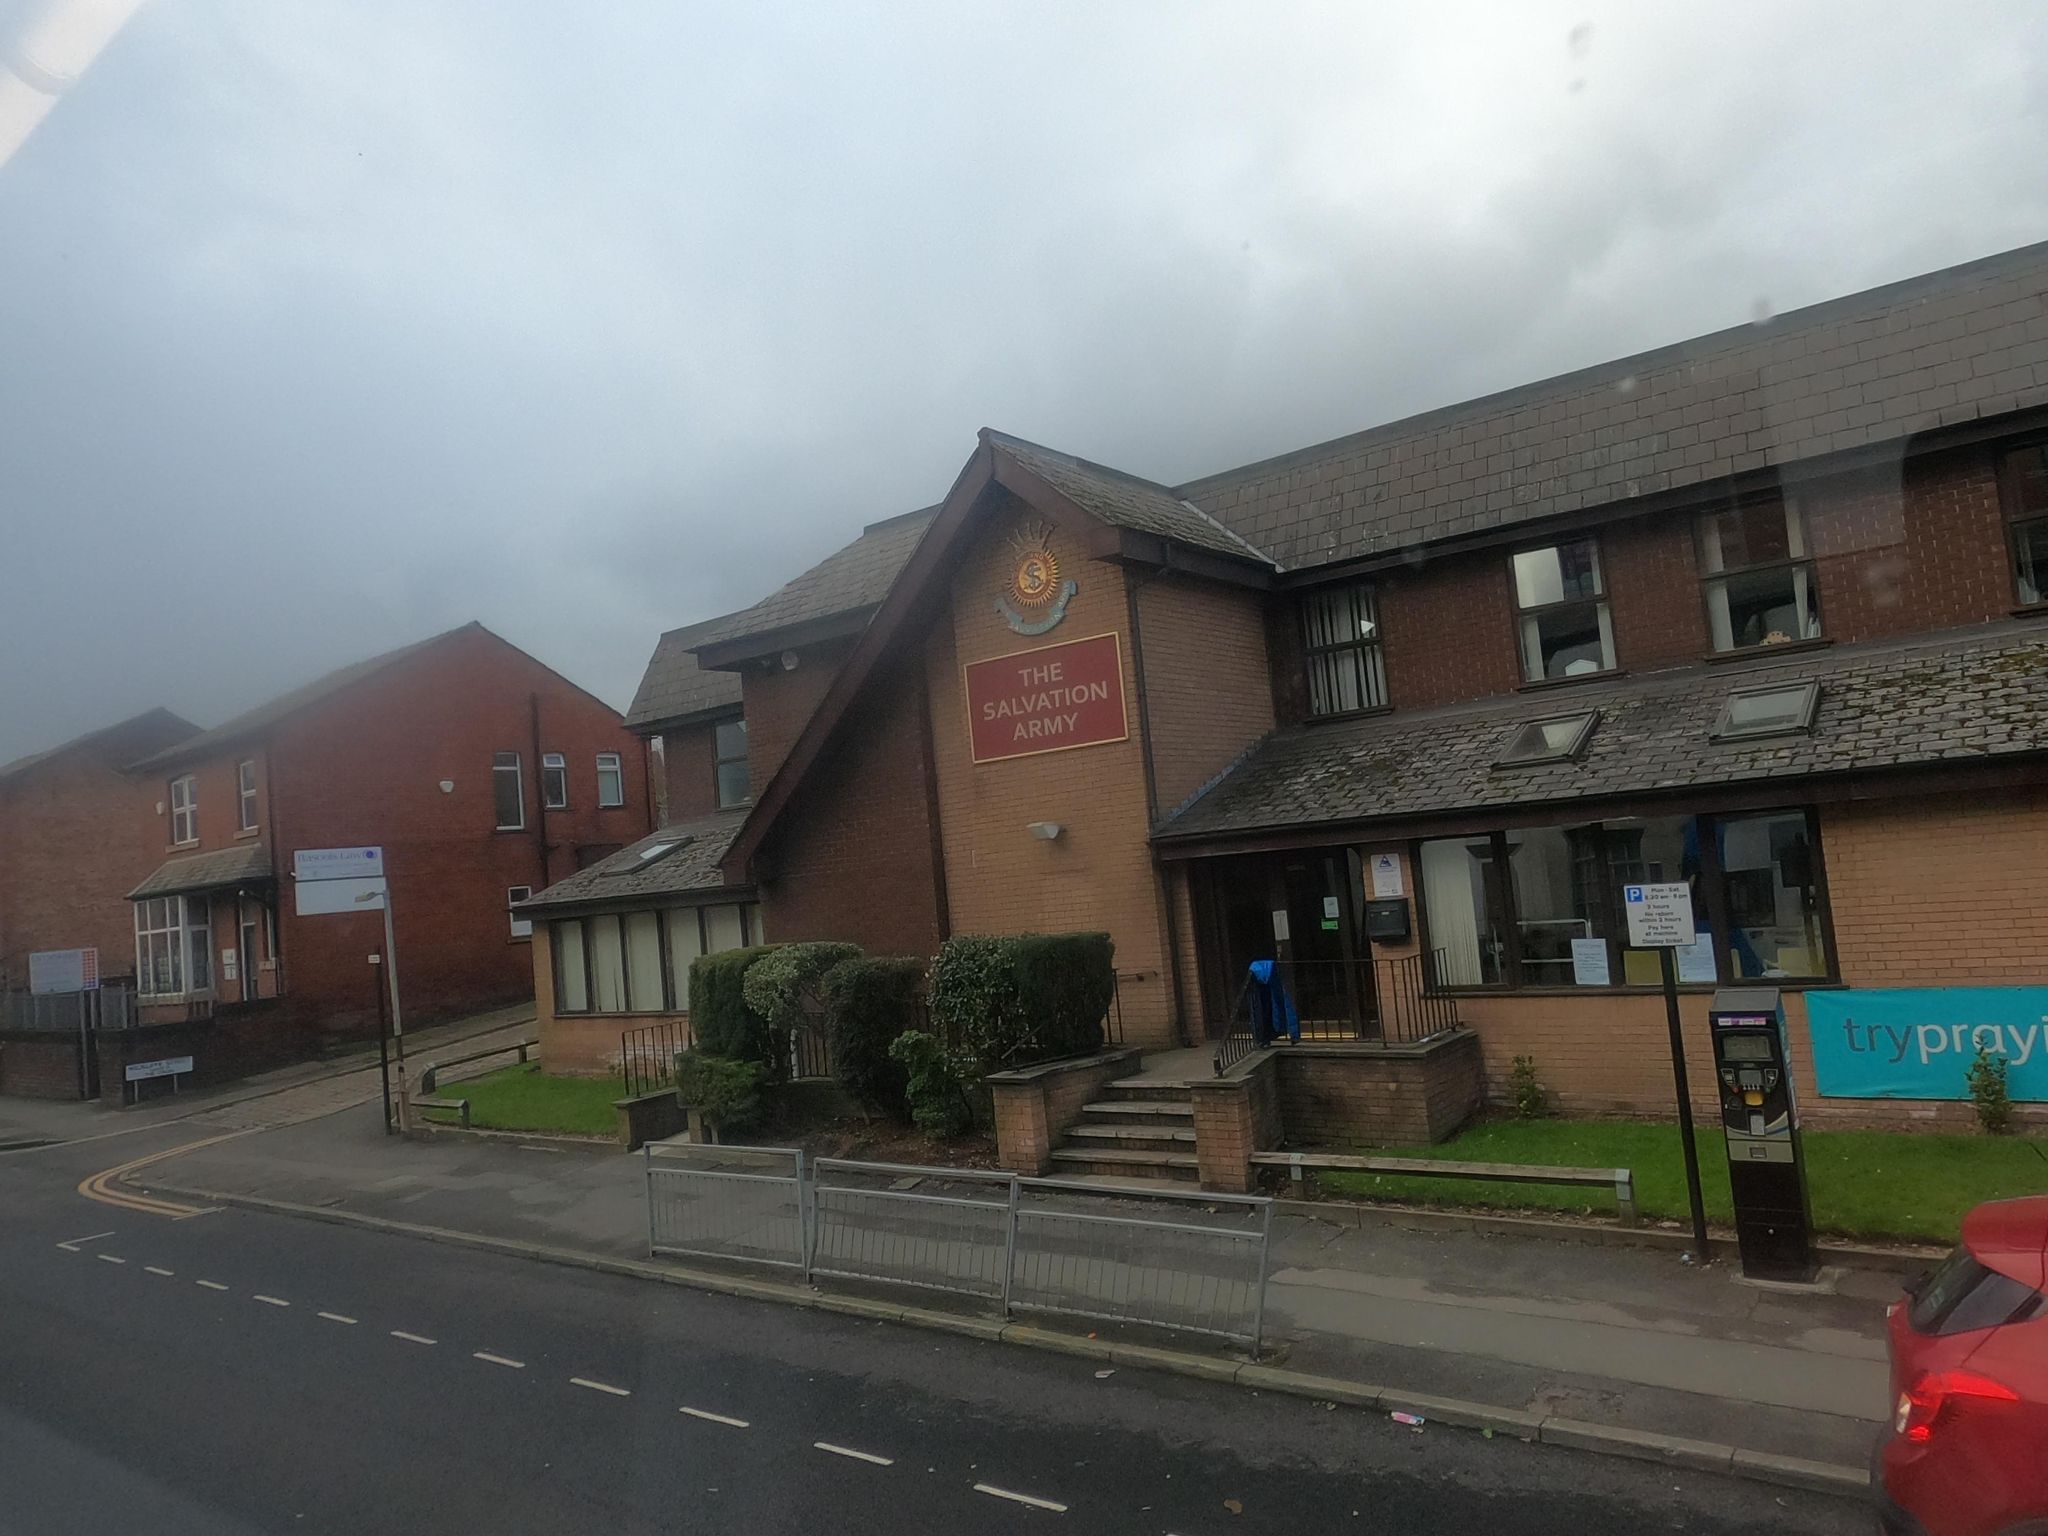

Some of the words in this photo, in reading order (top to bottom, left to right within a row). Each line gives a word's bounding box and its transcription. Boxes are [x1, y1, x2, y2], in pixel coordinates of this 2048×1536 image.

[1018, 662, 1064, 688] THE
[983, 680, 1109, 721] SALVATION
[1012, 712, 1079, 741] ARMY
[1629, 889, 1640, 901] P
